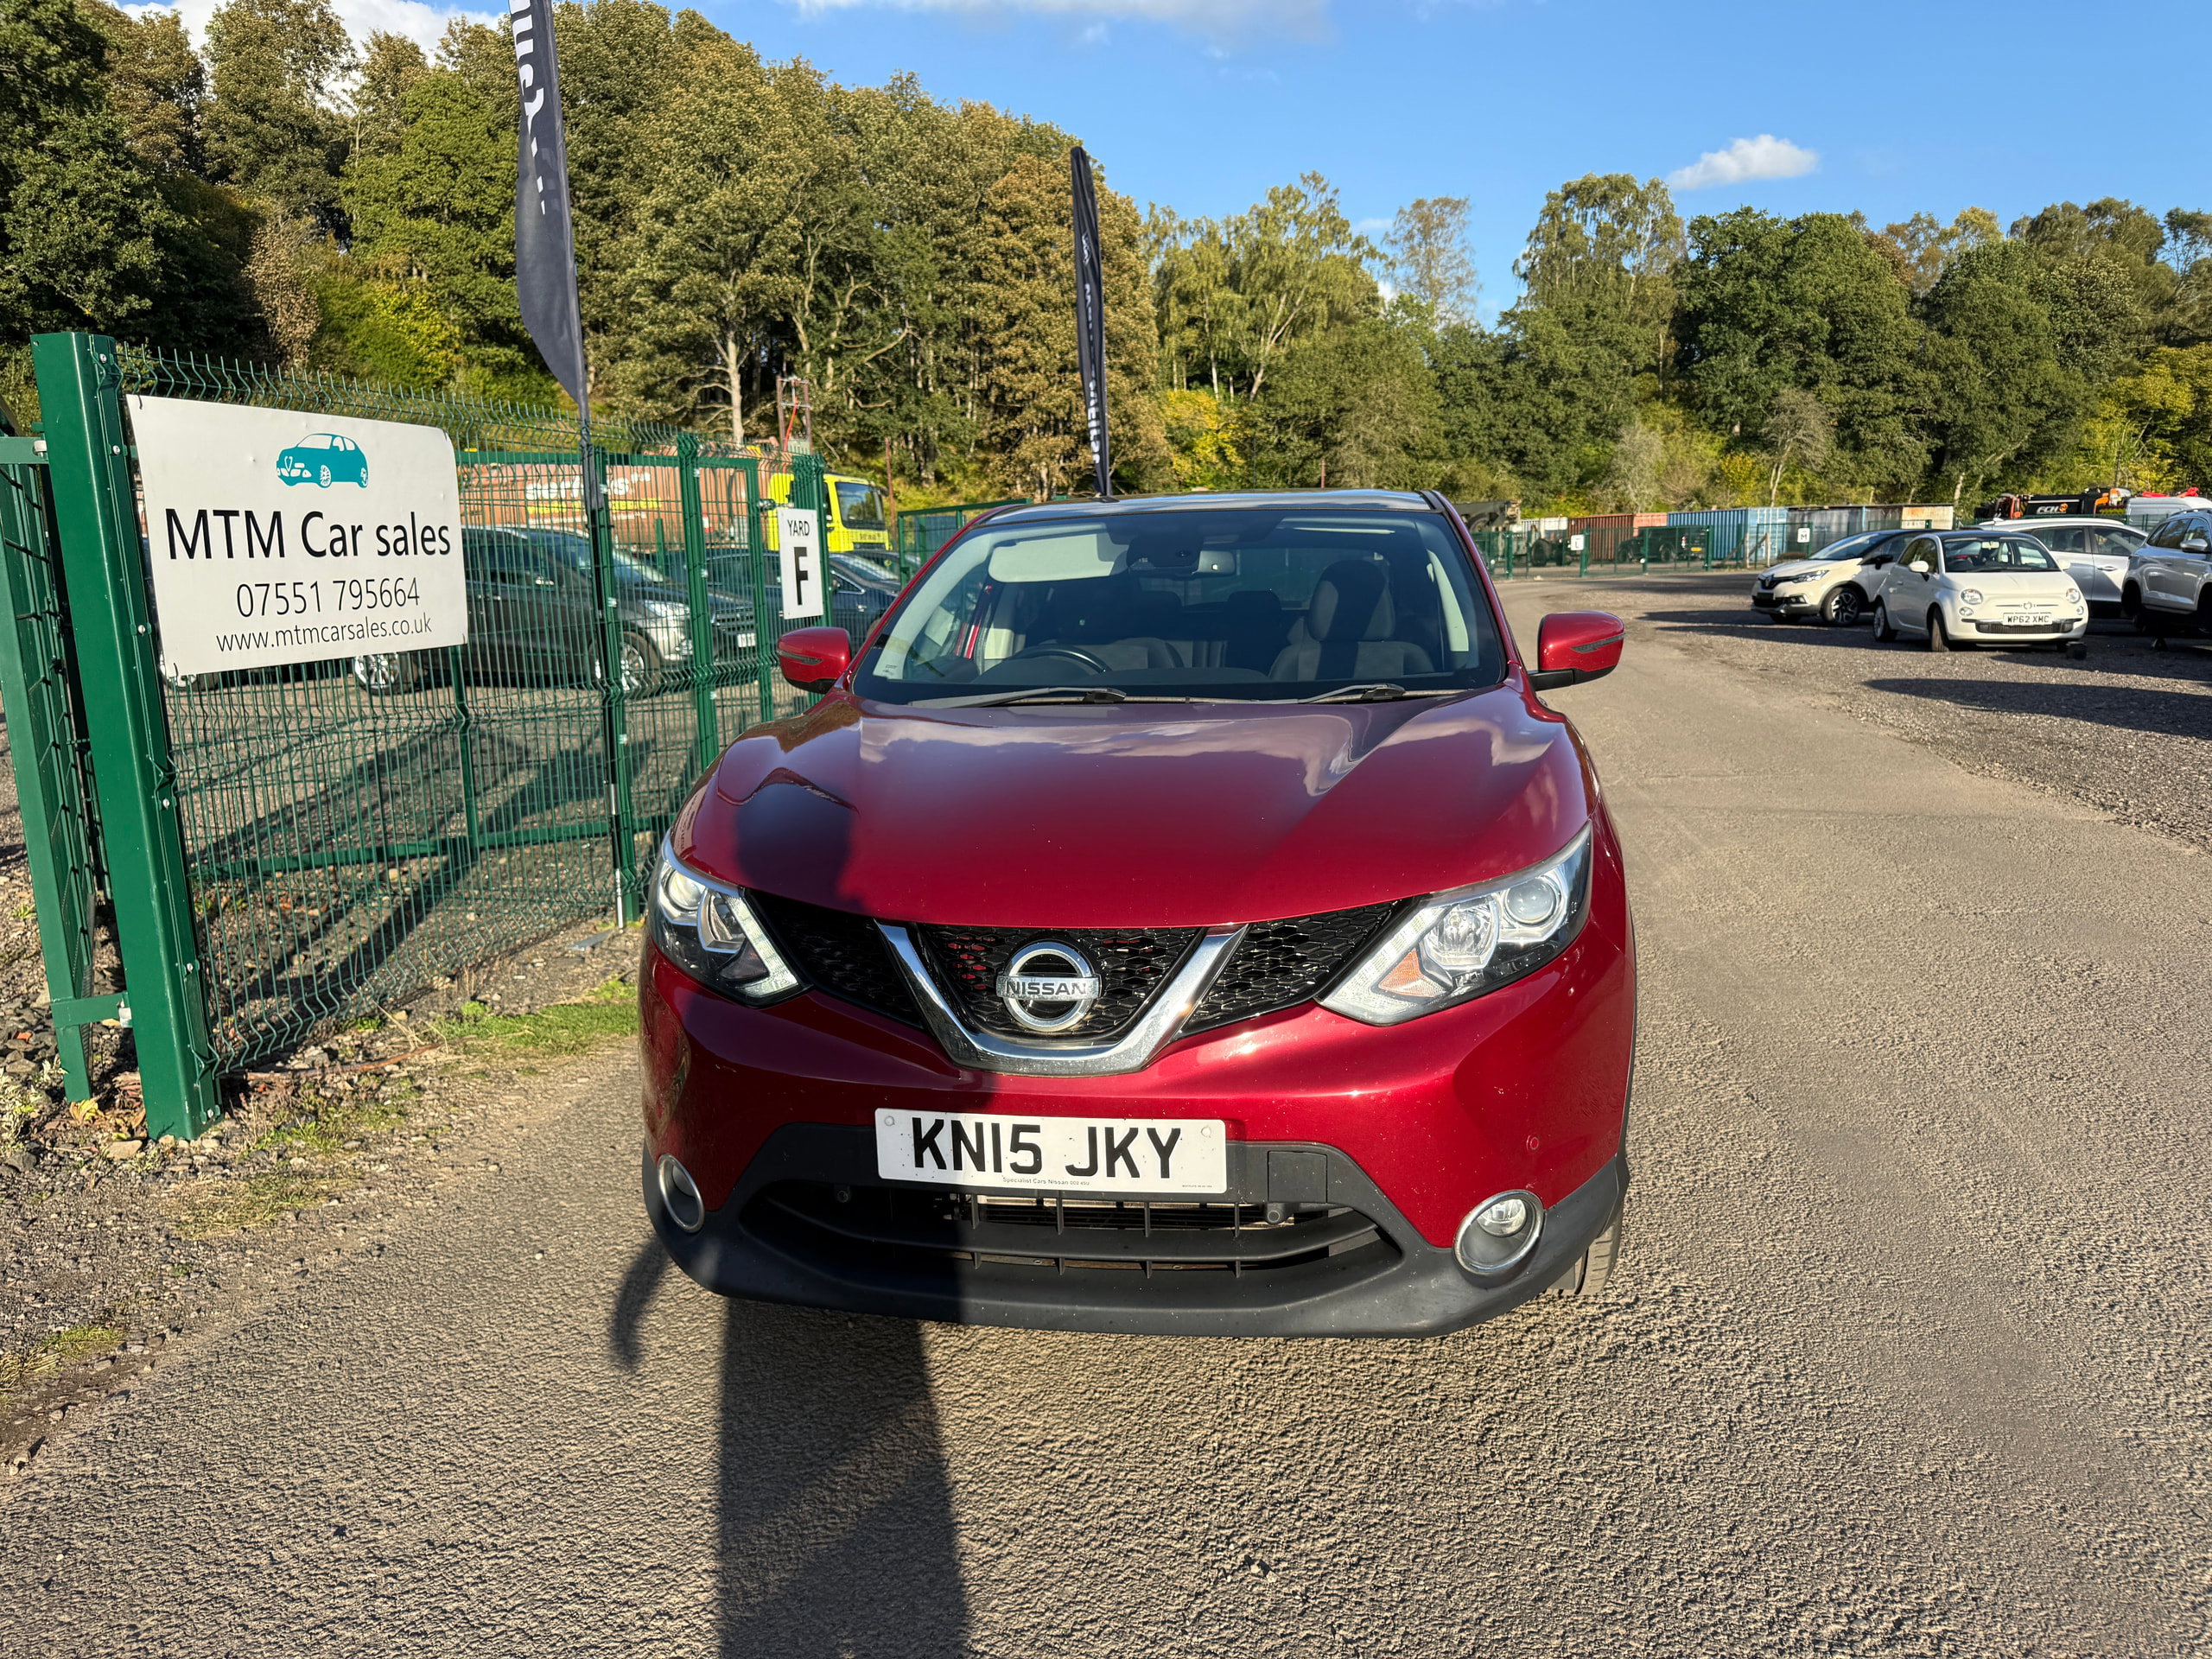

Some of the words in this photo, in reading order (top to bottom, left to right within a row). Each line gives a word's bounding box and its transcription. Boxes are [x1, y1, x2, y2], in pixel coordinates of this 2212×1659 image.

[165, 508, 285, 560] MTM
[301, 511, 364, 558] Car
[375, 511, 451, 556] sales
[787, 520, 810, 537] YARD
[236, 580, 321, 618] 07551
[332, 576, 420, 612] 795664
[793, 546, 809, 606] F
[216, 612, 432, 652] www.mtmcarsales.co.uk
[1006, 981, 1086, 995] NISSAN
[912, 1116, 1043, 1175] KN15
[1065, 1126, 1182, 1179] JKY
